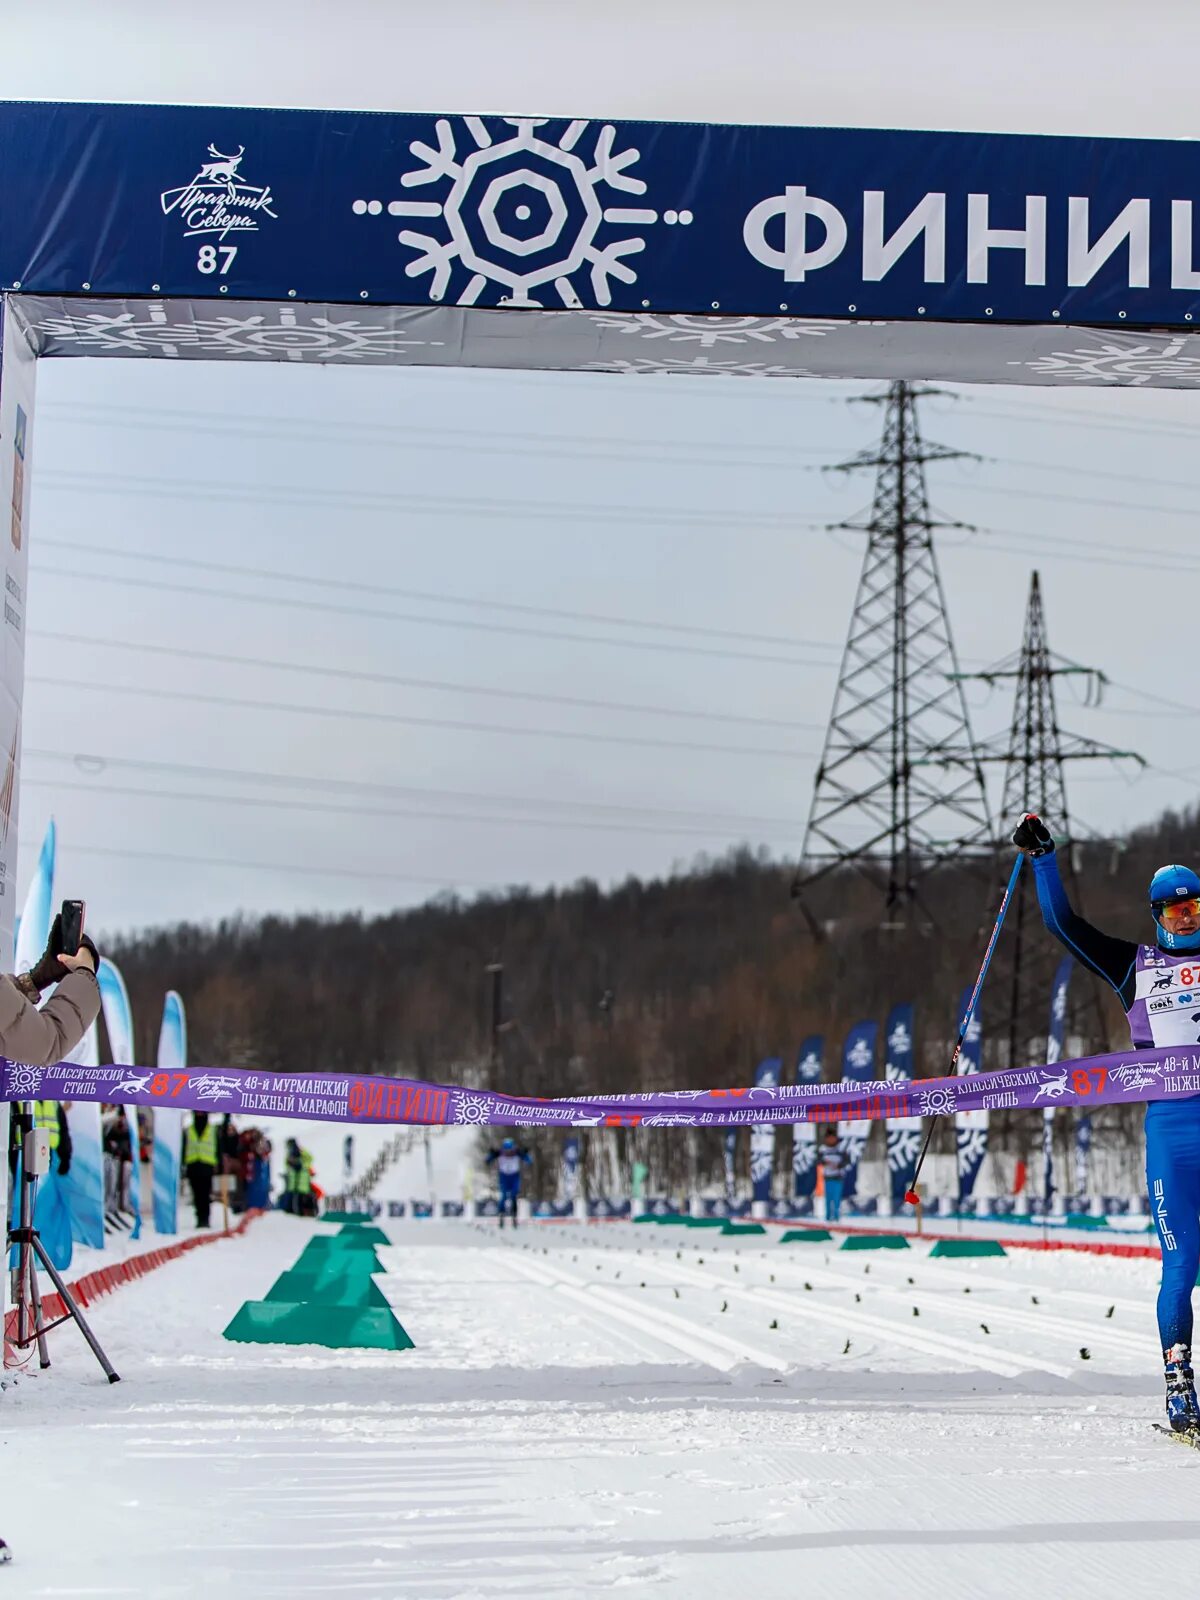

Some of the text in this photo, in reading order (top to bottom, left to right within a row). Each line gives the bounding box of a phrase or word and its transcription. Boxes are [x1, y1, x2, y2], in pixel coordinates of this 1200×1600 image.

[161, 182, 278, 218] Праздник
[184, 207, 259, 241] Севера
[197, 245, 238, 274] 87
[46, 1066, 124, 1081] КЛАССИЧЕСКИЙ
[1164, 1056, 1189, 1072] 48-й
[63, 1081, 97, 1095] СТИЛЬ
[151, 1073, 190, 1097] 87
[244, 1076, 350, 1097] 48-й МУРМАНСКИЙ
[957, 1070, 1040, 1095] КЛАССИЧЕСКИЙ
[1072, 1067, 1109, 1096] 87
[240, 1092, 349, 1117] ЛЫЖНЫЙ МАРАФОН
[350, 1081, 449, 1125] ФИНИШ
[493, 1102, 577, 1120] КЛАССИЧЕСКИЙ
[982, 1091, 1019, 1109] СТИЛЬ
[727, 1105, 808, 1123] МУРМАНСКИЙ
[1153, 1178, 1178, 1251] SPINE
